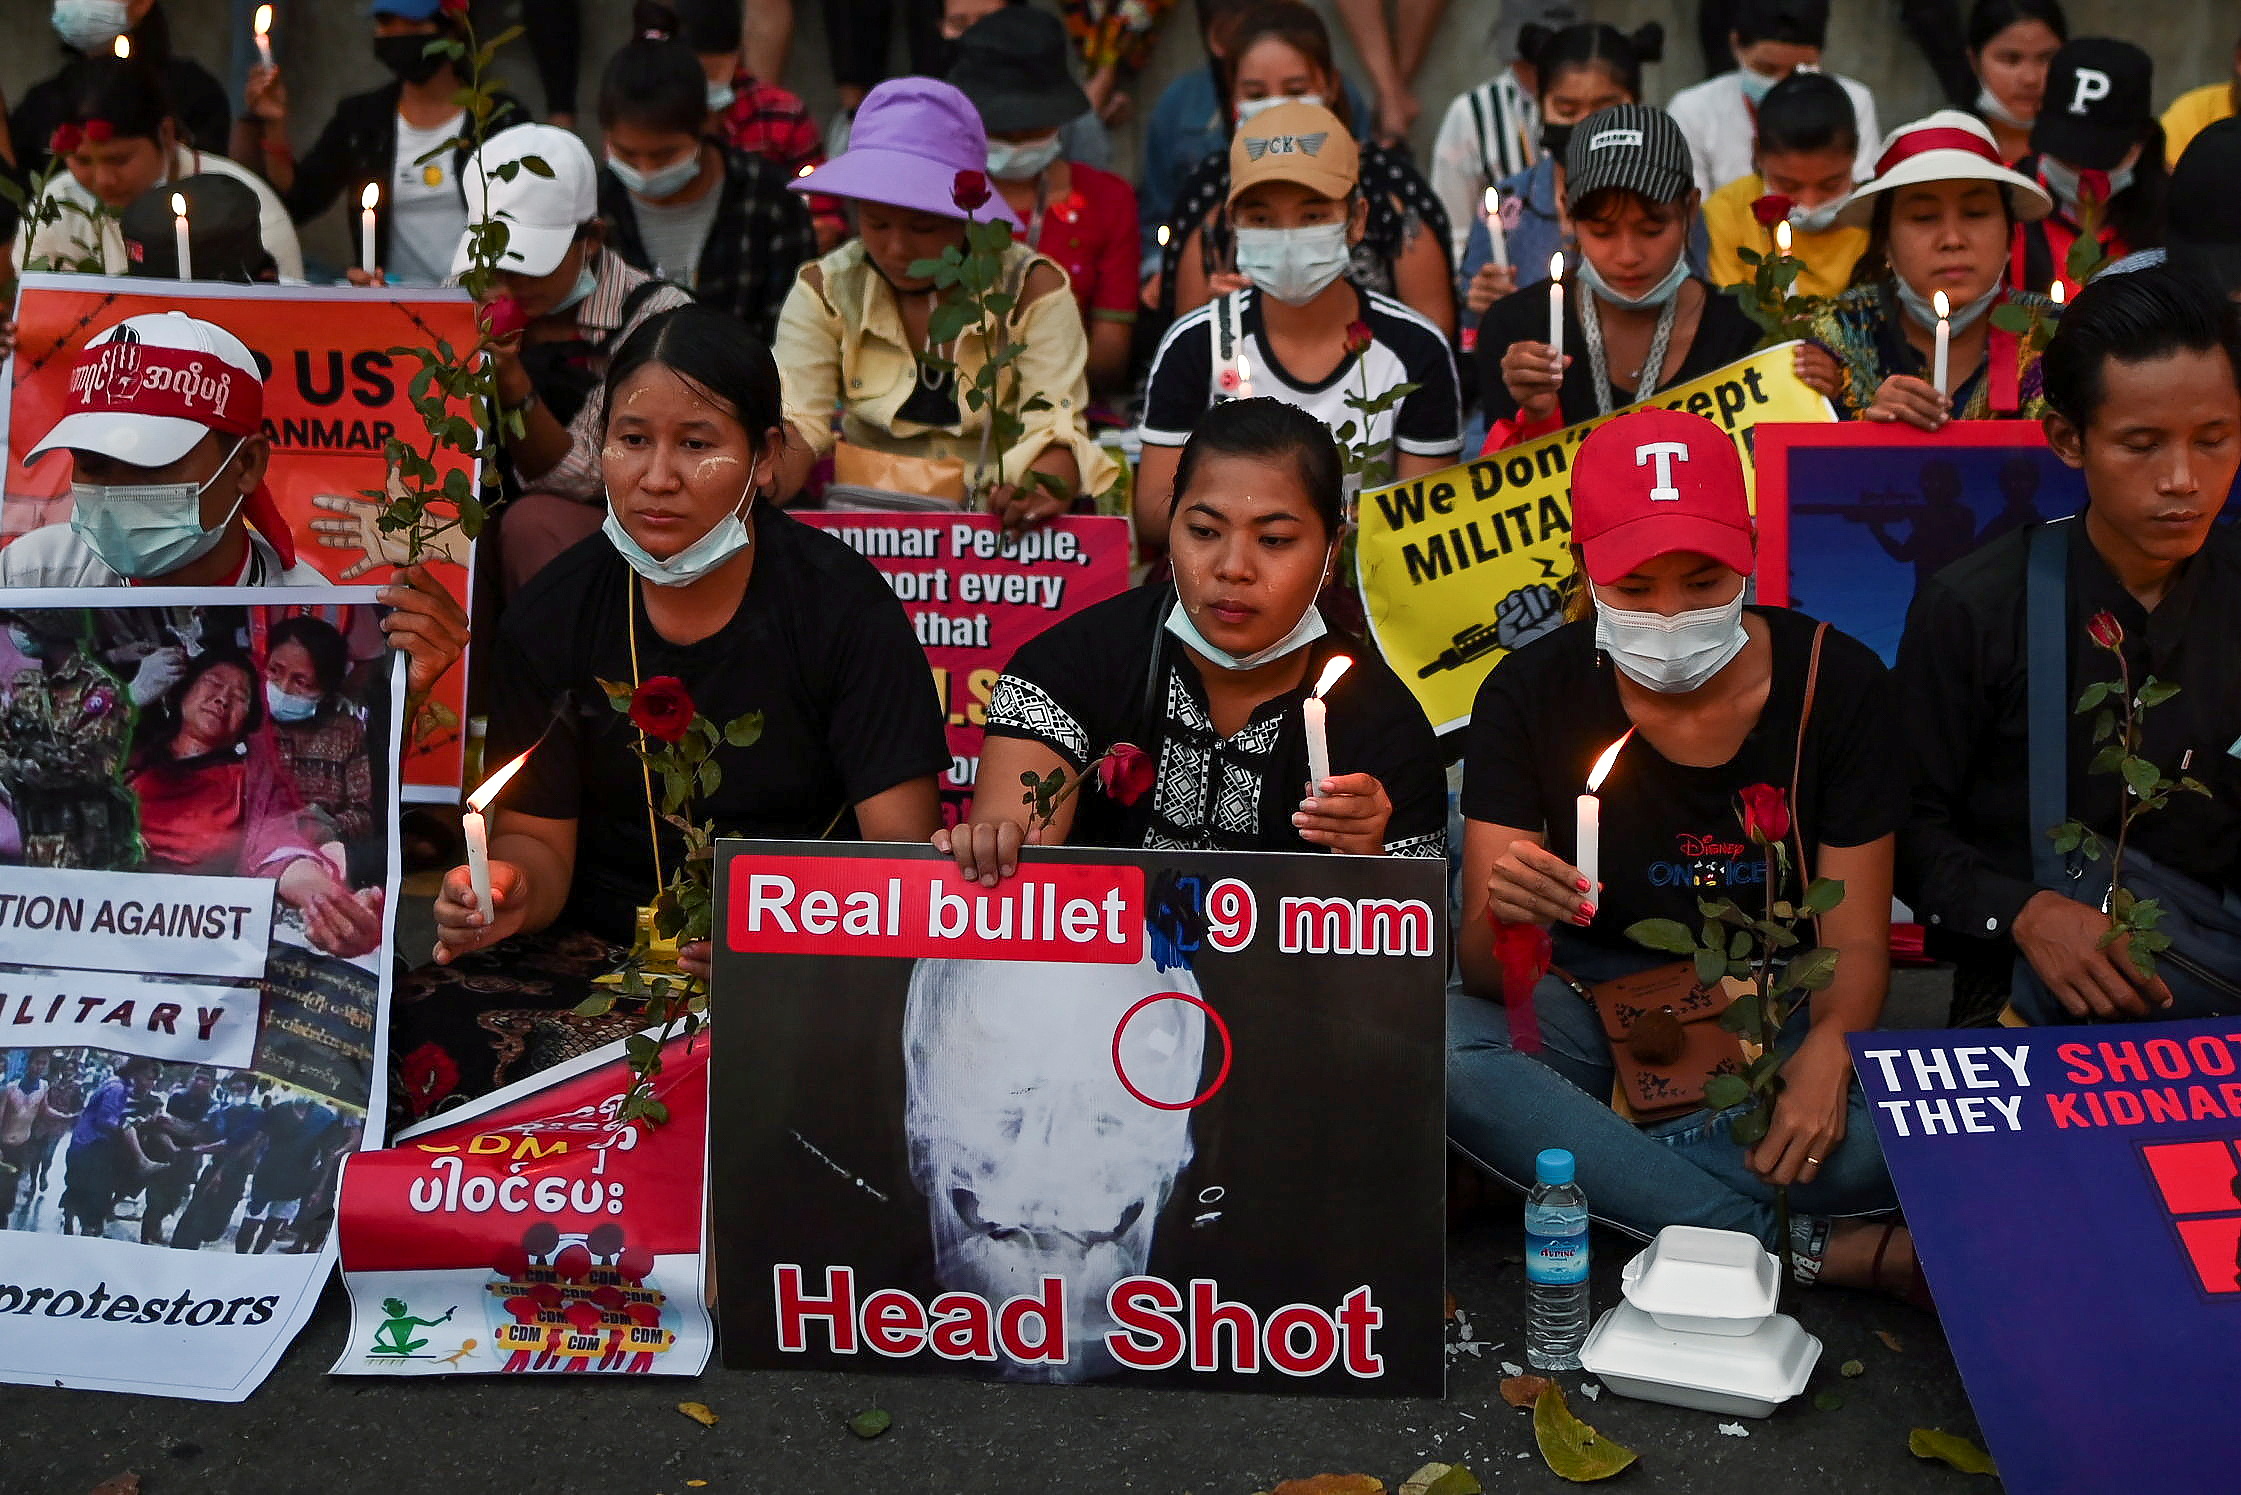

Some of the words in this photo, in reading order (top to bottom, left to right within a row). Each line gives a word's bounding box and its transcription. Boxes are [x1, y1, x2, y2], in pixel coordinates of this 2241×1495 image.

[2067, 66, 2112, 115] P
[1376, 480, 1456, 531] We
[1468, 430, 1592, 501] Don'
[1666, 367, 1768, 429] ept
[1635, 441, 1689, 501] T
[1401, 488, 1572, 586] MILITA
[959, 572, 1064, 609] every
[914, 612, 989, 646] that
[90, 901, 252, 940] AGAINST
[748, 874, 901, 936] Real
[928, 879, 1127, 944] bullet
[1206, 878, 1258, 953] 9
[1279, 896, 1434, 957] mm
[1863, 1045, 2031, 1092] THEY
[1877, 1095, 2022, 1137] THEY
[508, 1325, 541, 1343] CDM
[630, 1327, 663, 1345] CDM
[774, 1264, 1068, 1365] Head
[1104, 1276, 1384, 1378] Shot
[567, 1335, 600, 1352] CDM
